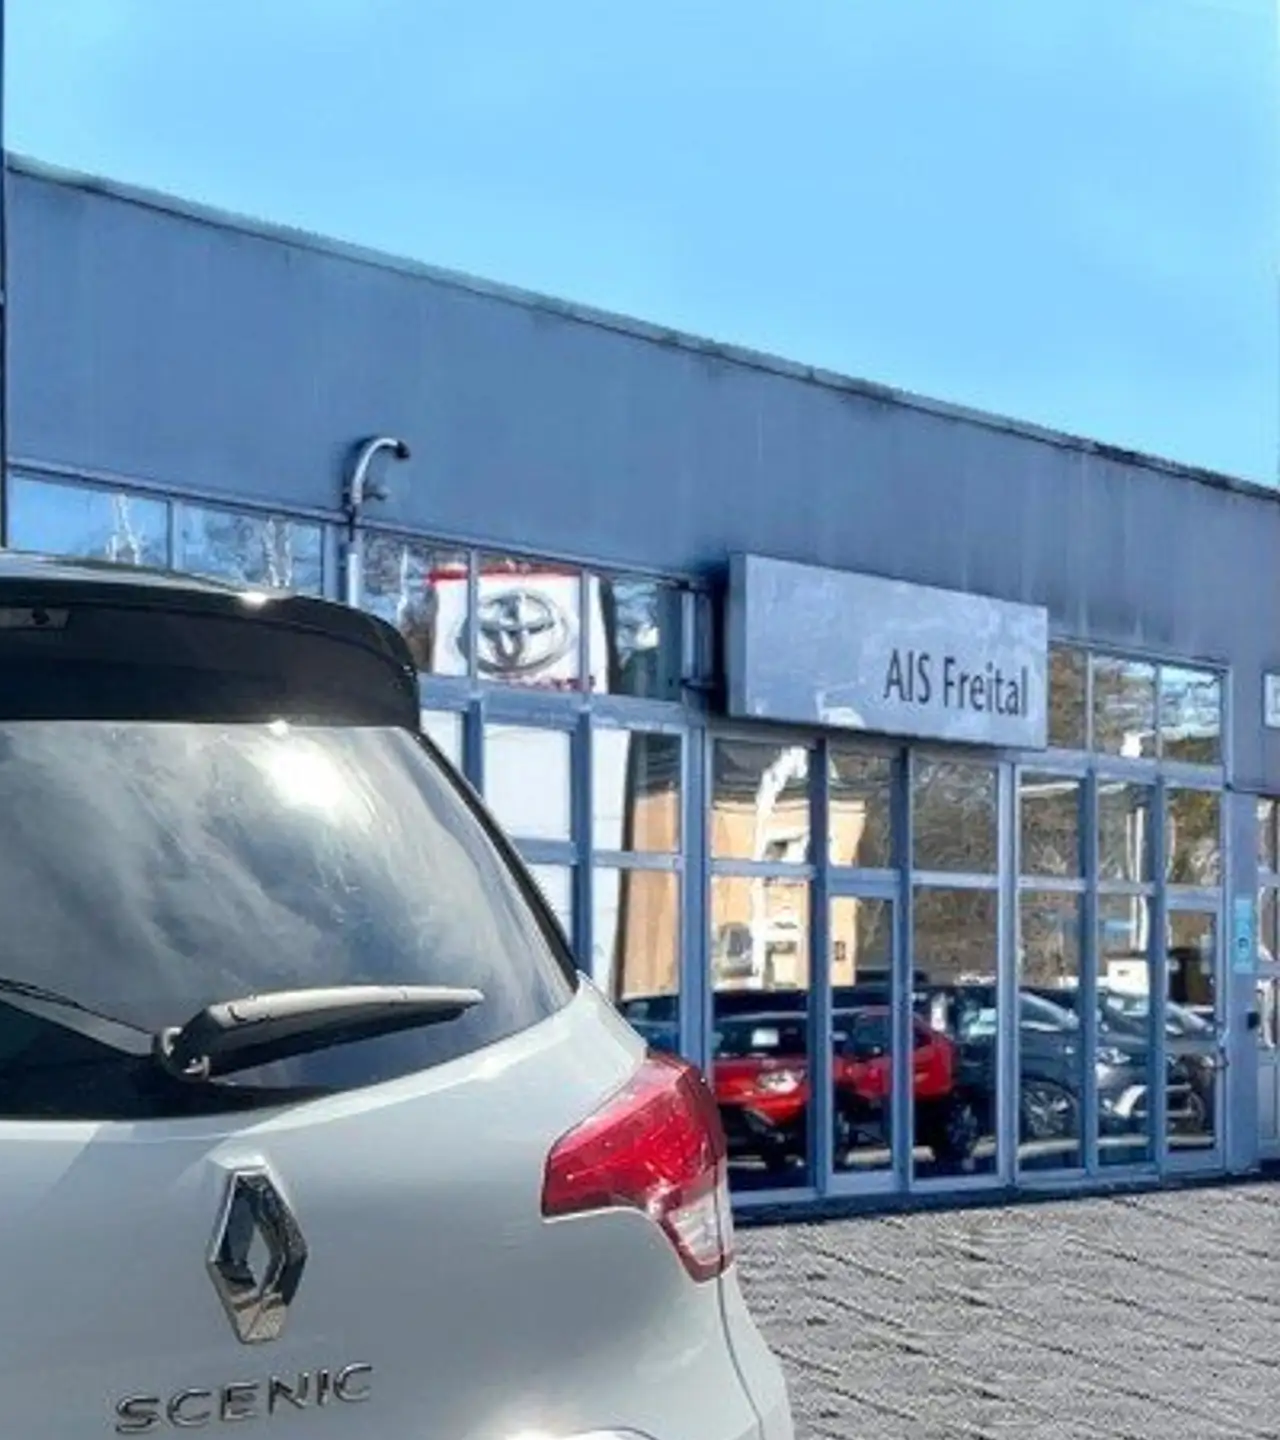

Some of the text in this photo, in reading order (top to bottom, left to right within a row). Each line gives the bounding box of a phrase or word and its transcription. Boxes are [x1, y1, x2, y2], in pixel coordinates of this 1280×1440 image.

[883, 648, 1028, 718] AIS Freital
[114, 1361, 374, 1435] SCENIC
